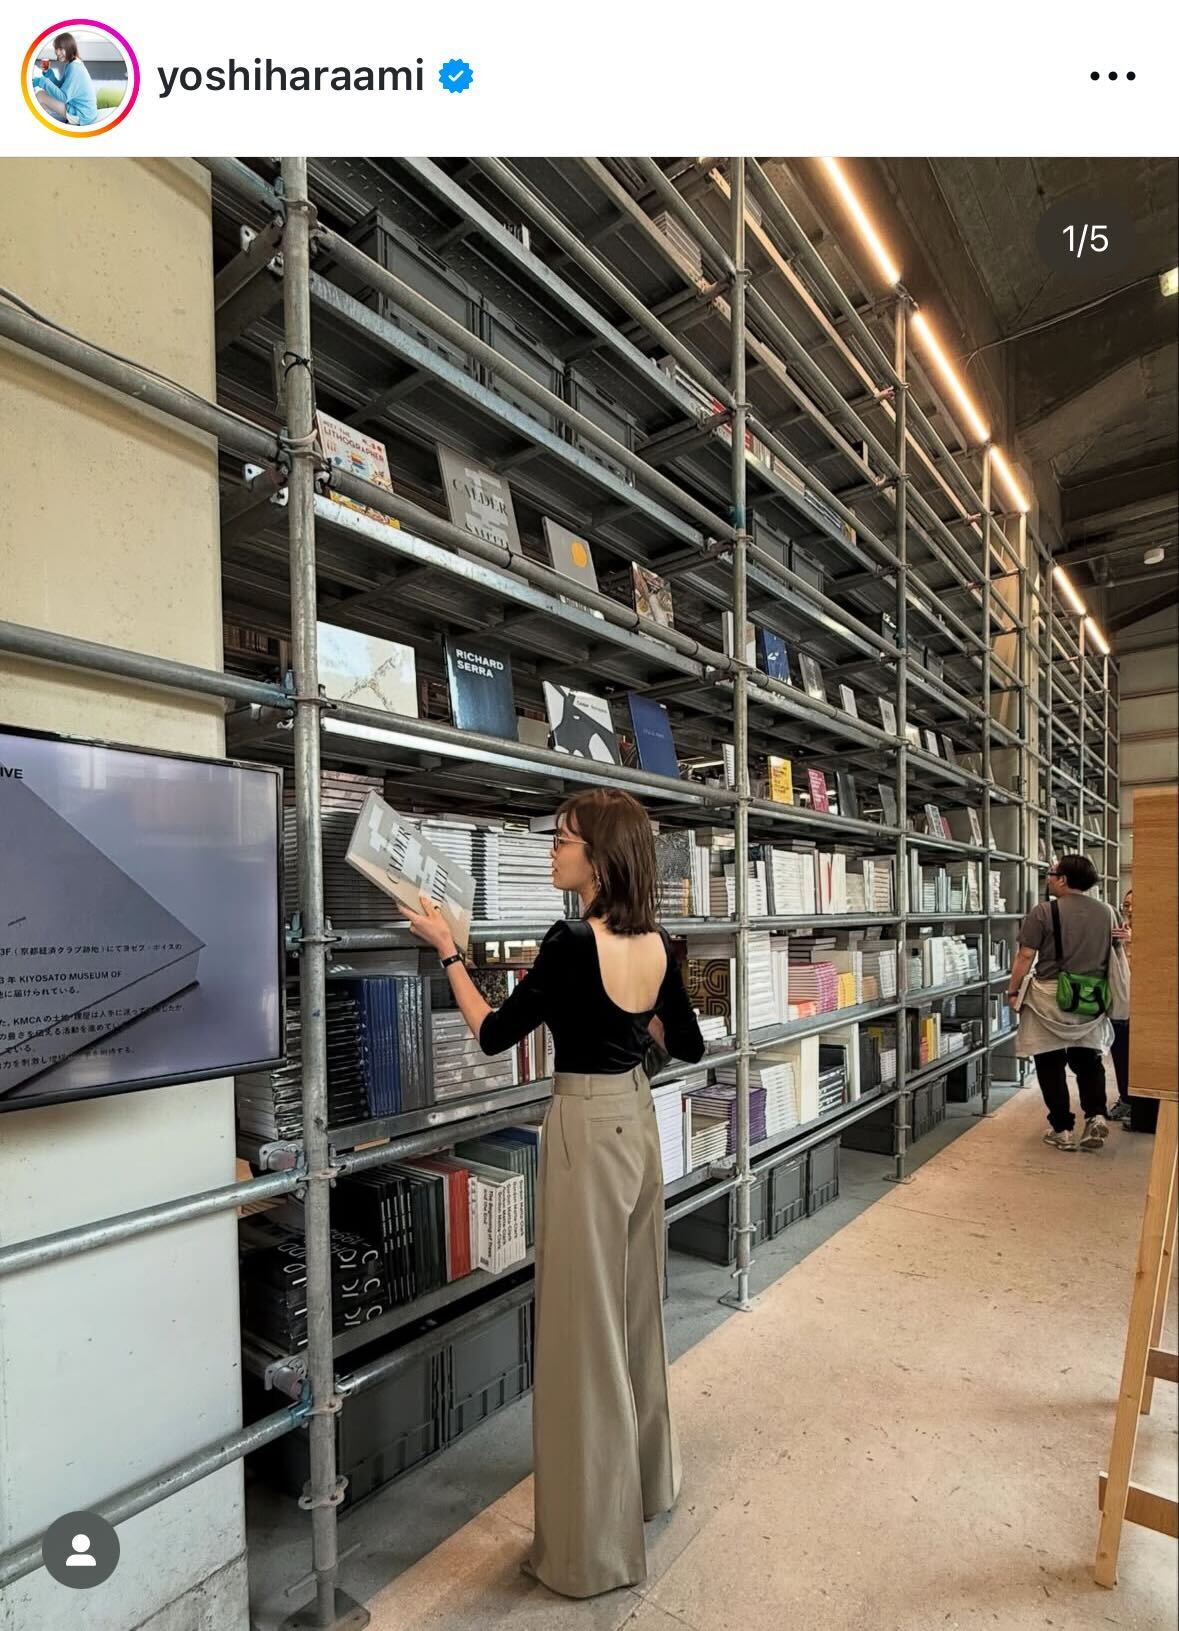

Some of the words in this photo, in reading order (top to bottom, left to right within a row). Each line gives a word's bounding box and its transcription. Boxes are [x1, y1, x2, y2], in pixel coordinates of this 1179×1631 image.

[455, 648, 505, 671] RICHARD
[456, 659, 494, 679] SERRA
[19, 973, 67, 983] KIYOSATO
[69, 970, 109, 981] MUSEUM
[110, 970, 123, 979] OF
